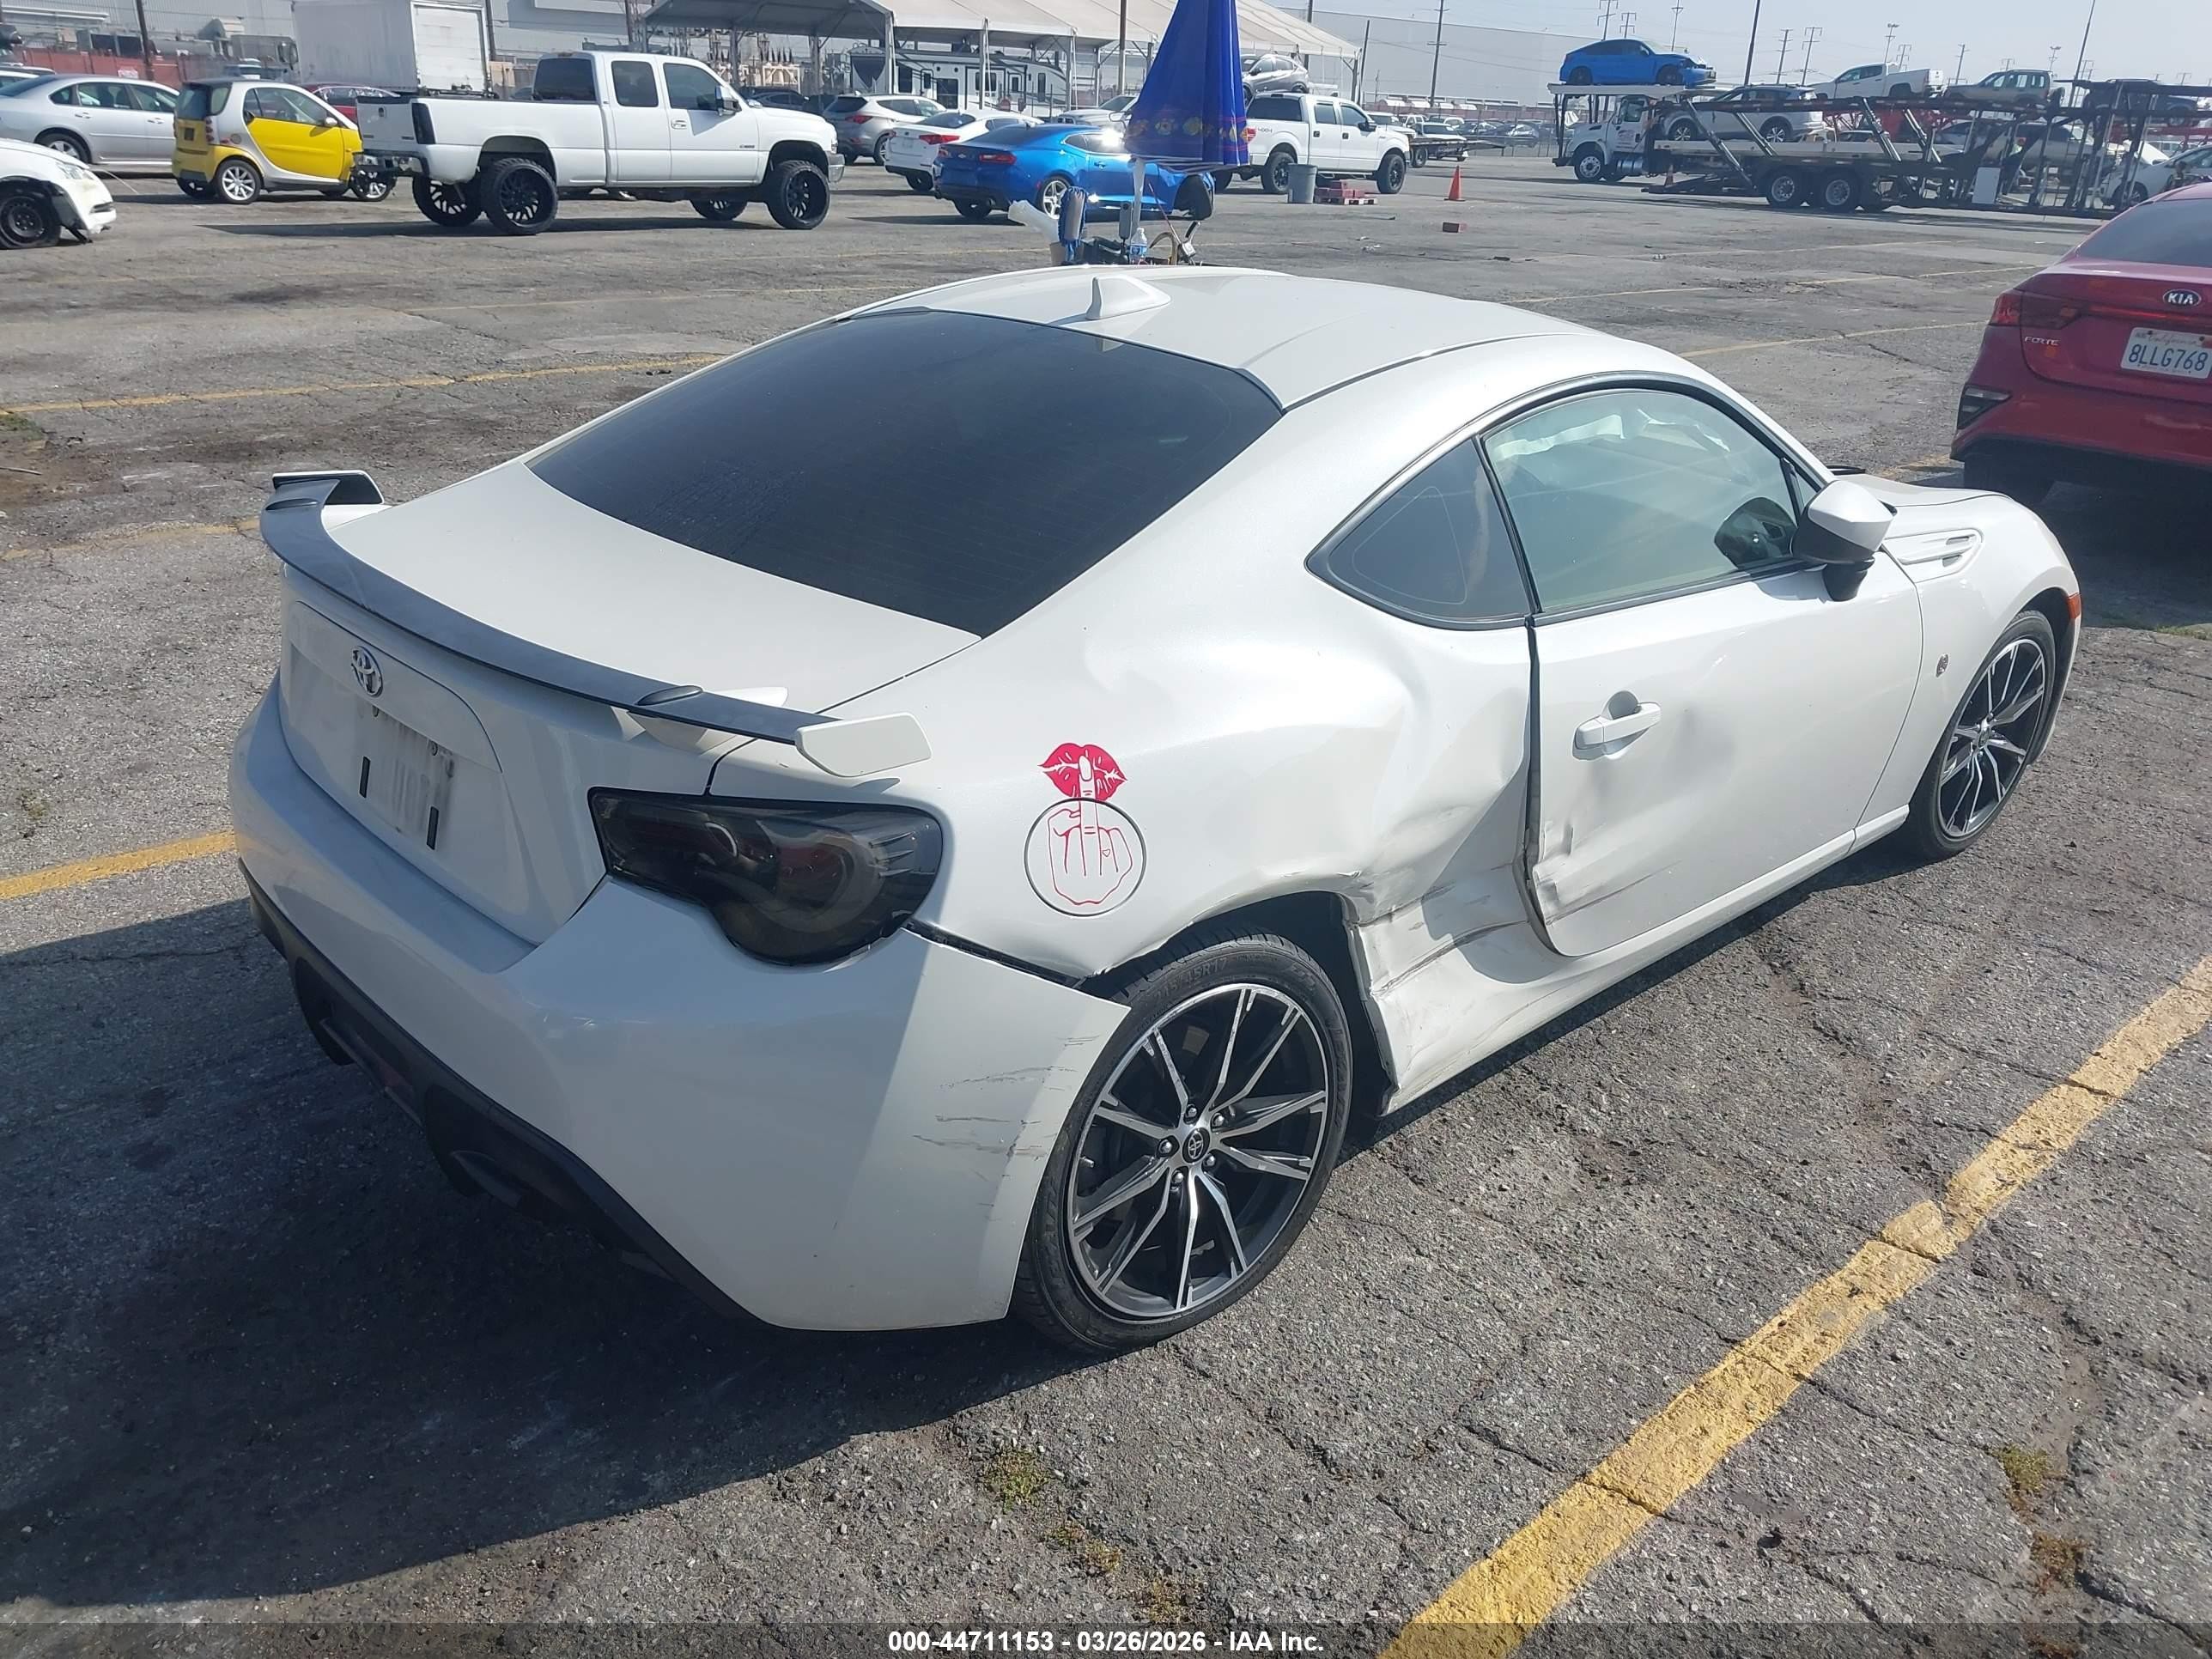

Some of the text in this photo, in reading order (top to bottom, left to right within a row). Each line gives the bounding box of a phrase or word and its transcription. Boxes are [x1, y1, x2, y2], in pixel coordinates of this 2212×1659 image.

[2167, 293, 2194, 305] KIA
[2025, 336, 2060, 346] FORTE
[2129, 343, 2209, 371] 8LLG768
